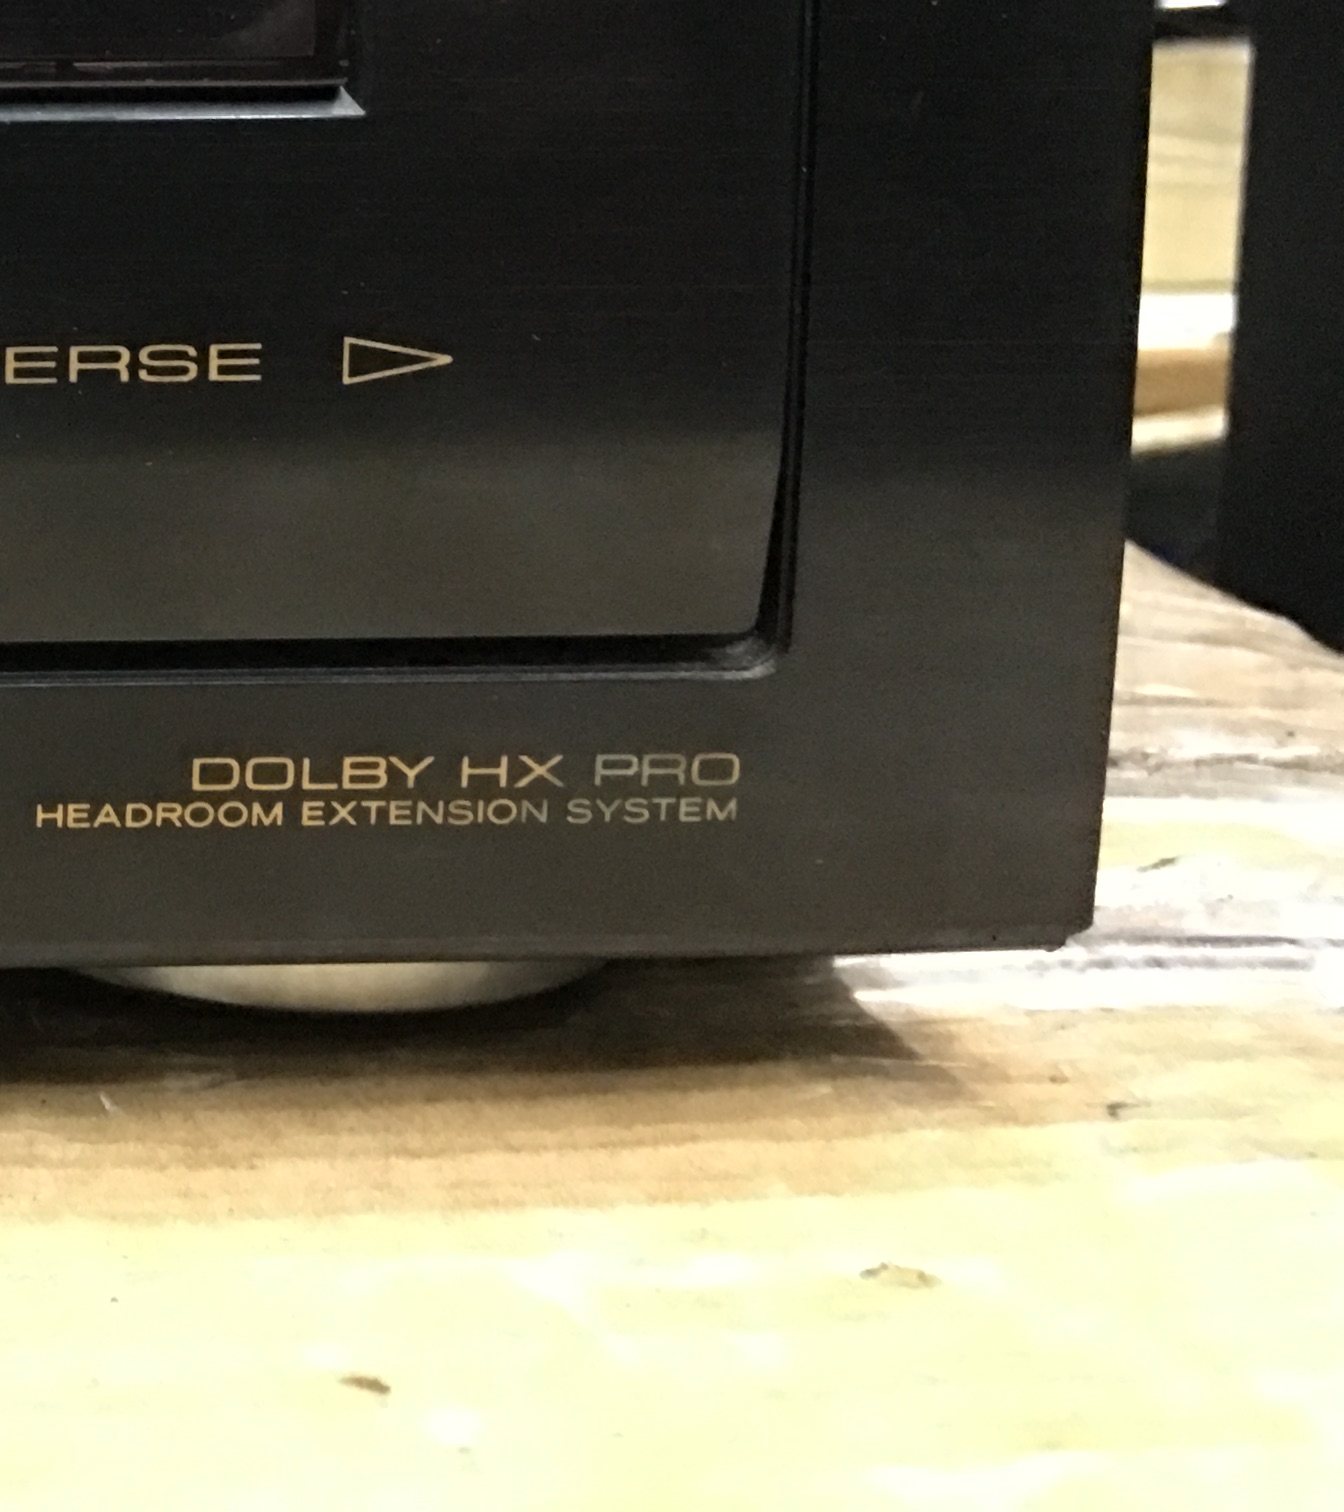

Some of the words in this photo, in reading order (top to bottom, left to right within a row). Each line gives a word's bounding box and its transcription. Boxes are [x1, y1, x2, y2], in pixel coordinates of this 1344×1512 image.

[191, 756, 435, 792] DOLBY
[460, 755, 563, 788] HX
[594, 752, 741, 787] PRO
[36, 800, 284, 829] HEADROOM
[301, 798, 548, 827] EXTENSION
[566, 796, 737, 824] SYSTEM
